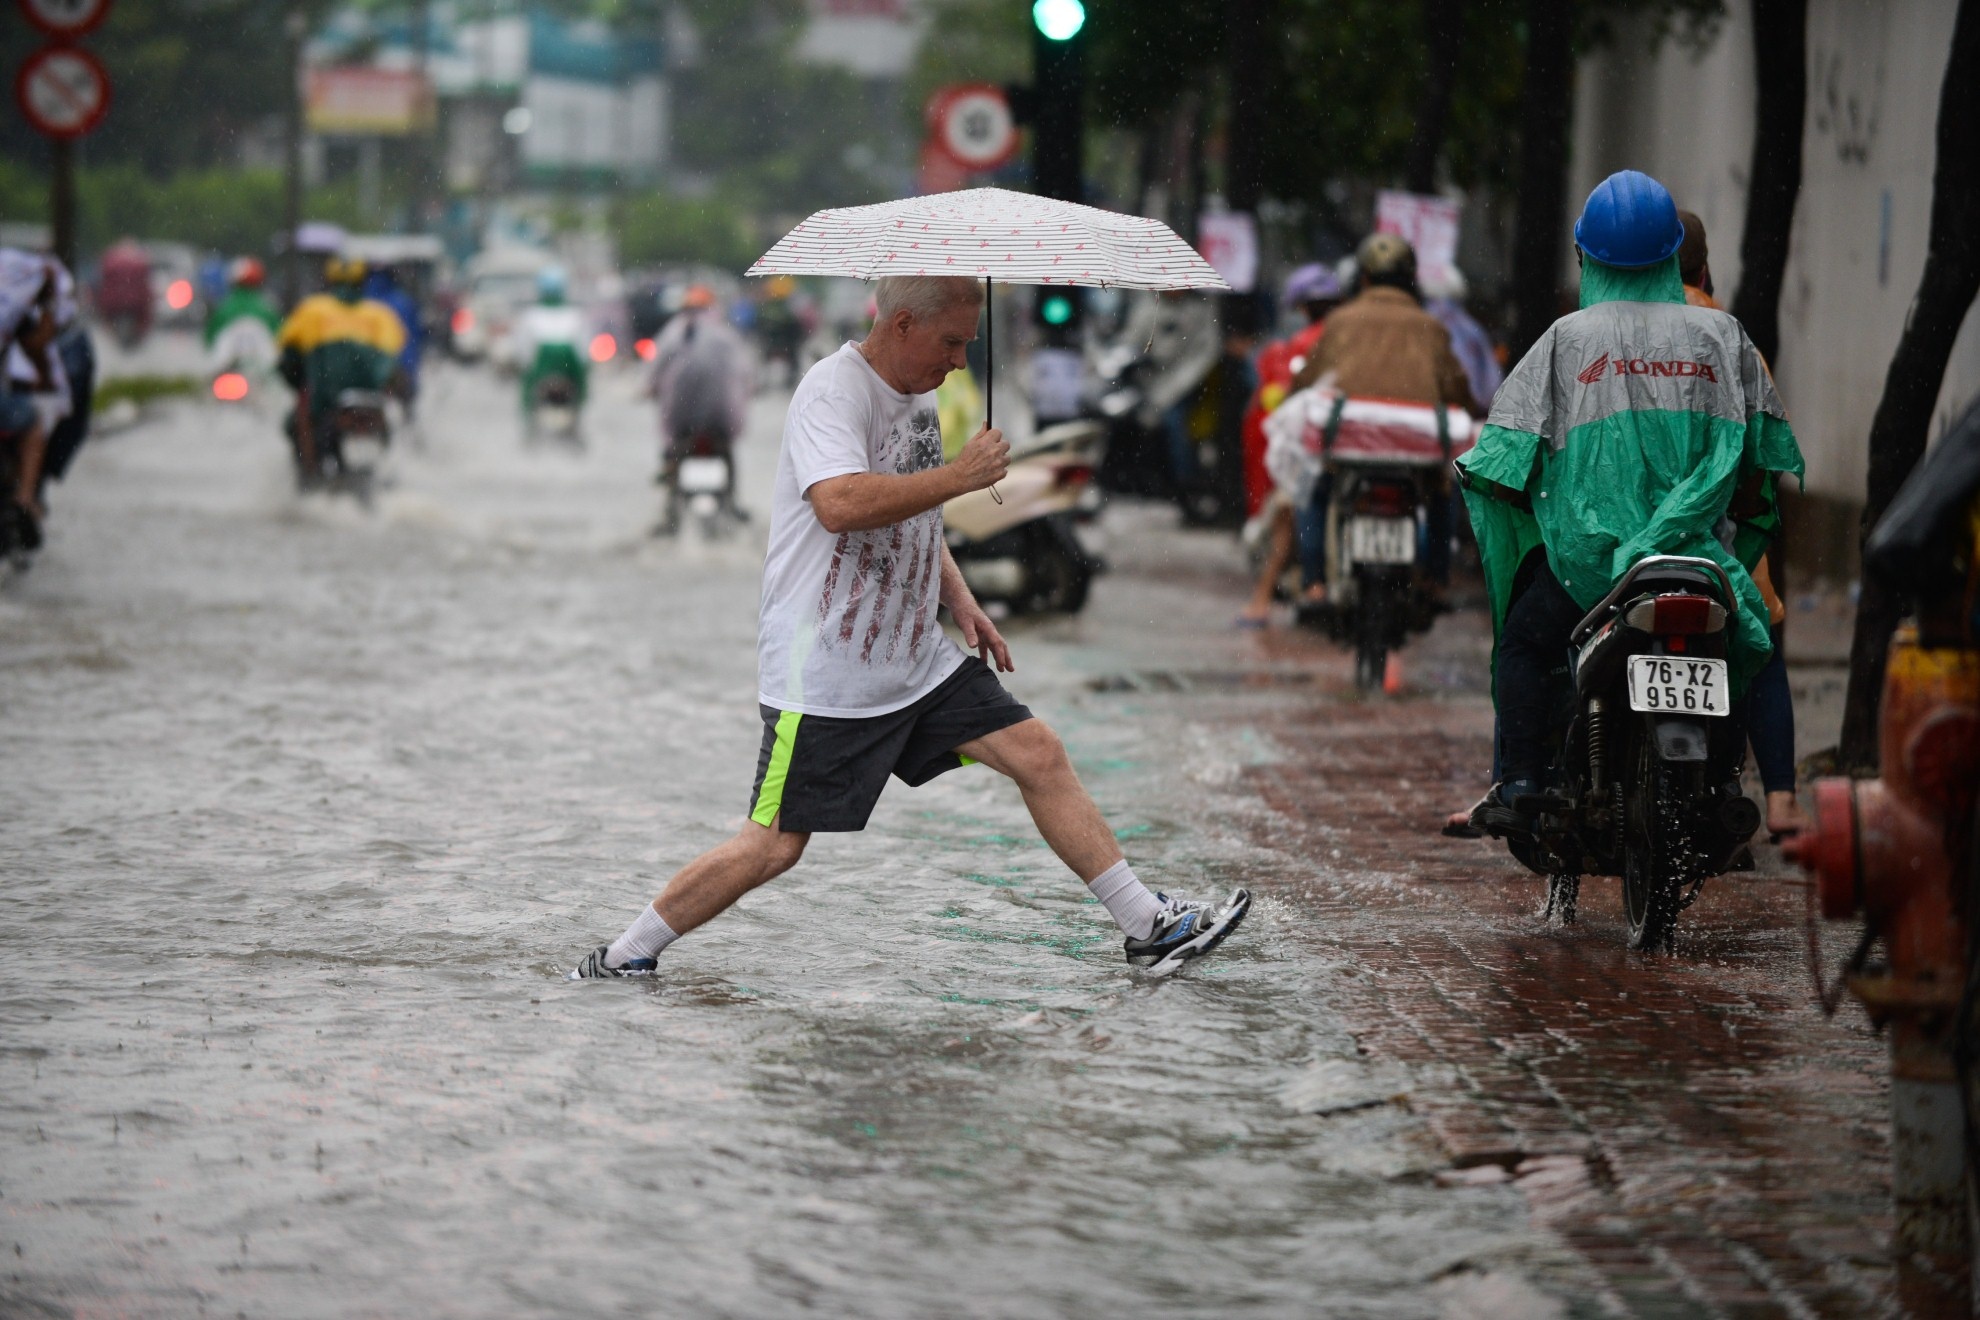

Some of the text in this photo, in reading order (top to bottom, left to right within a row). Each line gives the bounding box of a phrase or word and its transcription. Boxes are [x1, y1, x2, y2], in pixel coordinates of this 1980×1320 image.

[1612, 358, 1719, 384] HONDA
[1645, 660, 1714, 687] 76-X2
[1646, 686, 1715, 711] 9564
